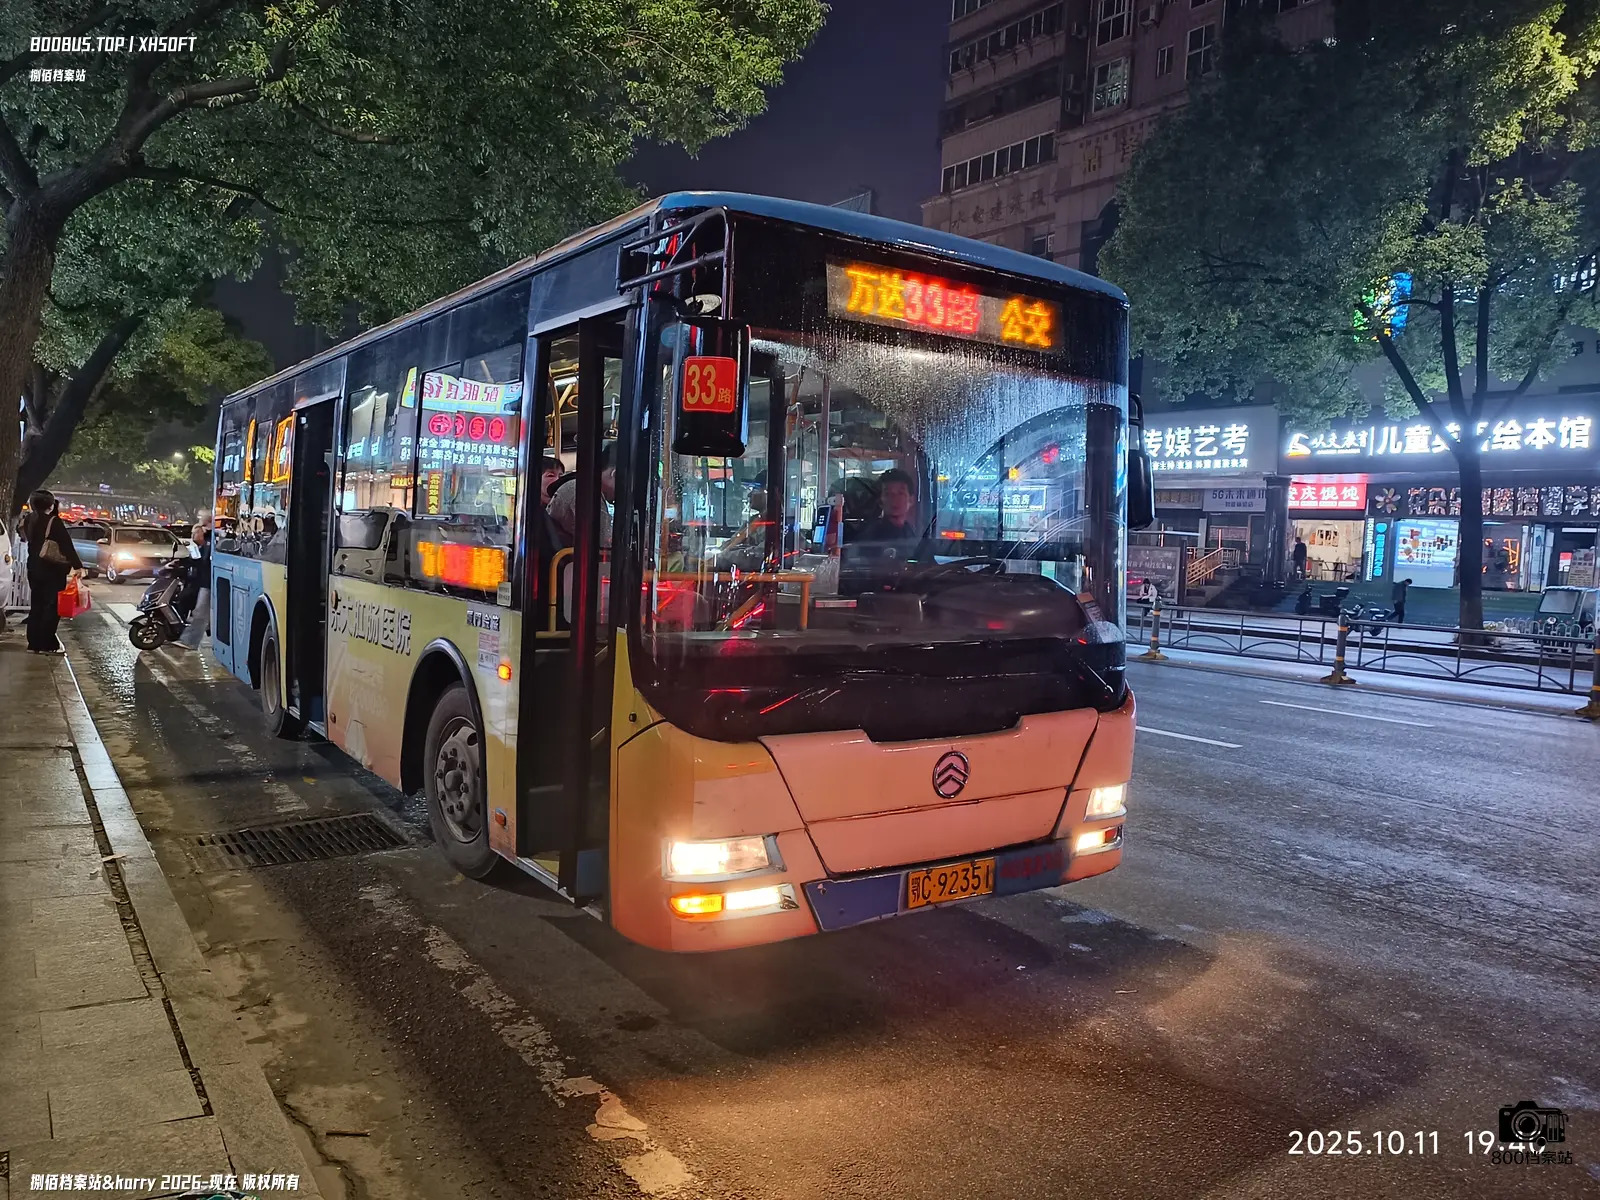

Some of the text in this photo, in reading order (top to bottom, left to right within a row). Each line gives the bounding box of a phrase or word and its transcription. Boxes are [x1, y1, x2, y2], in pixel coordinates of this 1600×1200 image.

[1000, 297, 1052, 347] 公交
[1143, 423, 1249, 458] 传媒艺考
[1375, 416, 1593, 455] 儿童绘本馆
